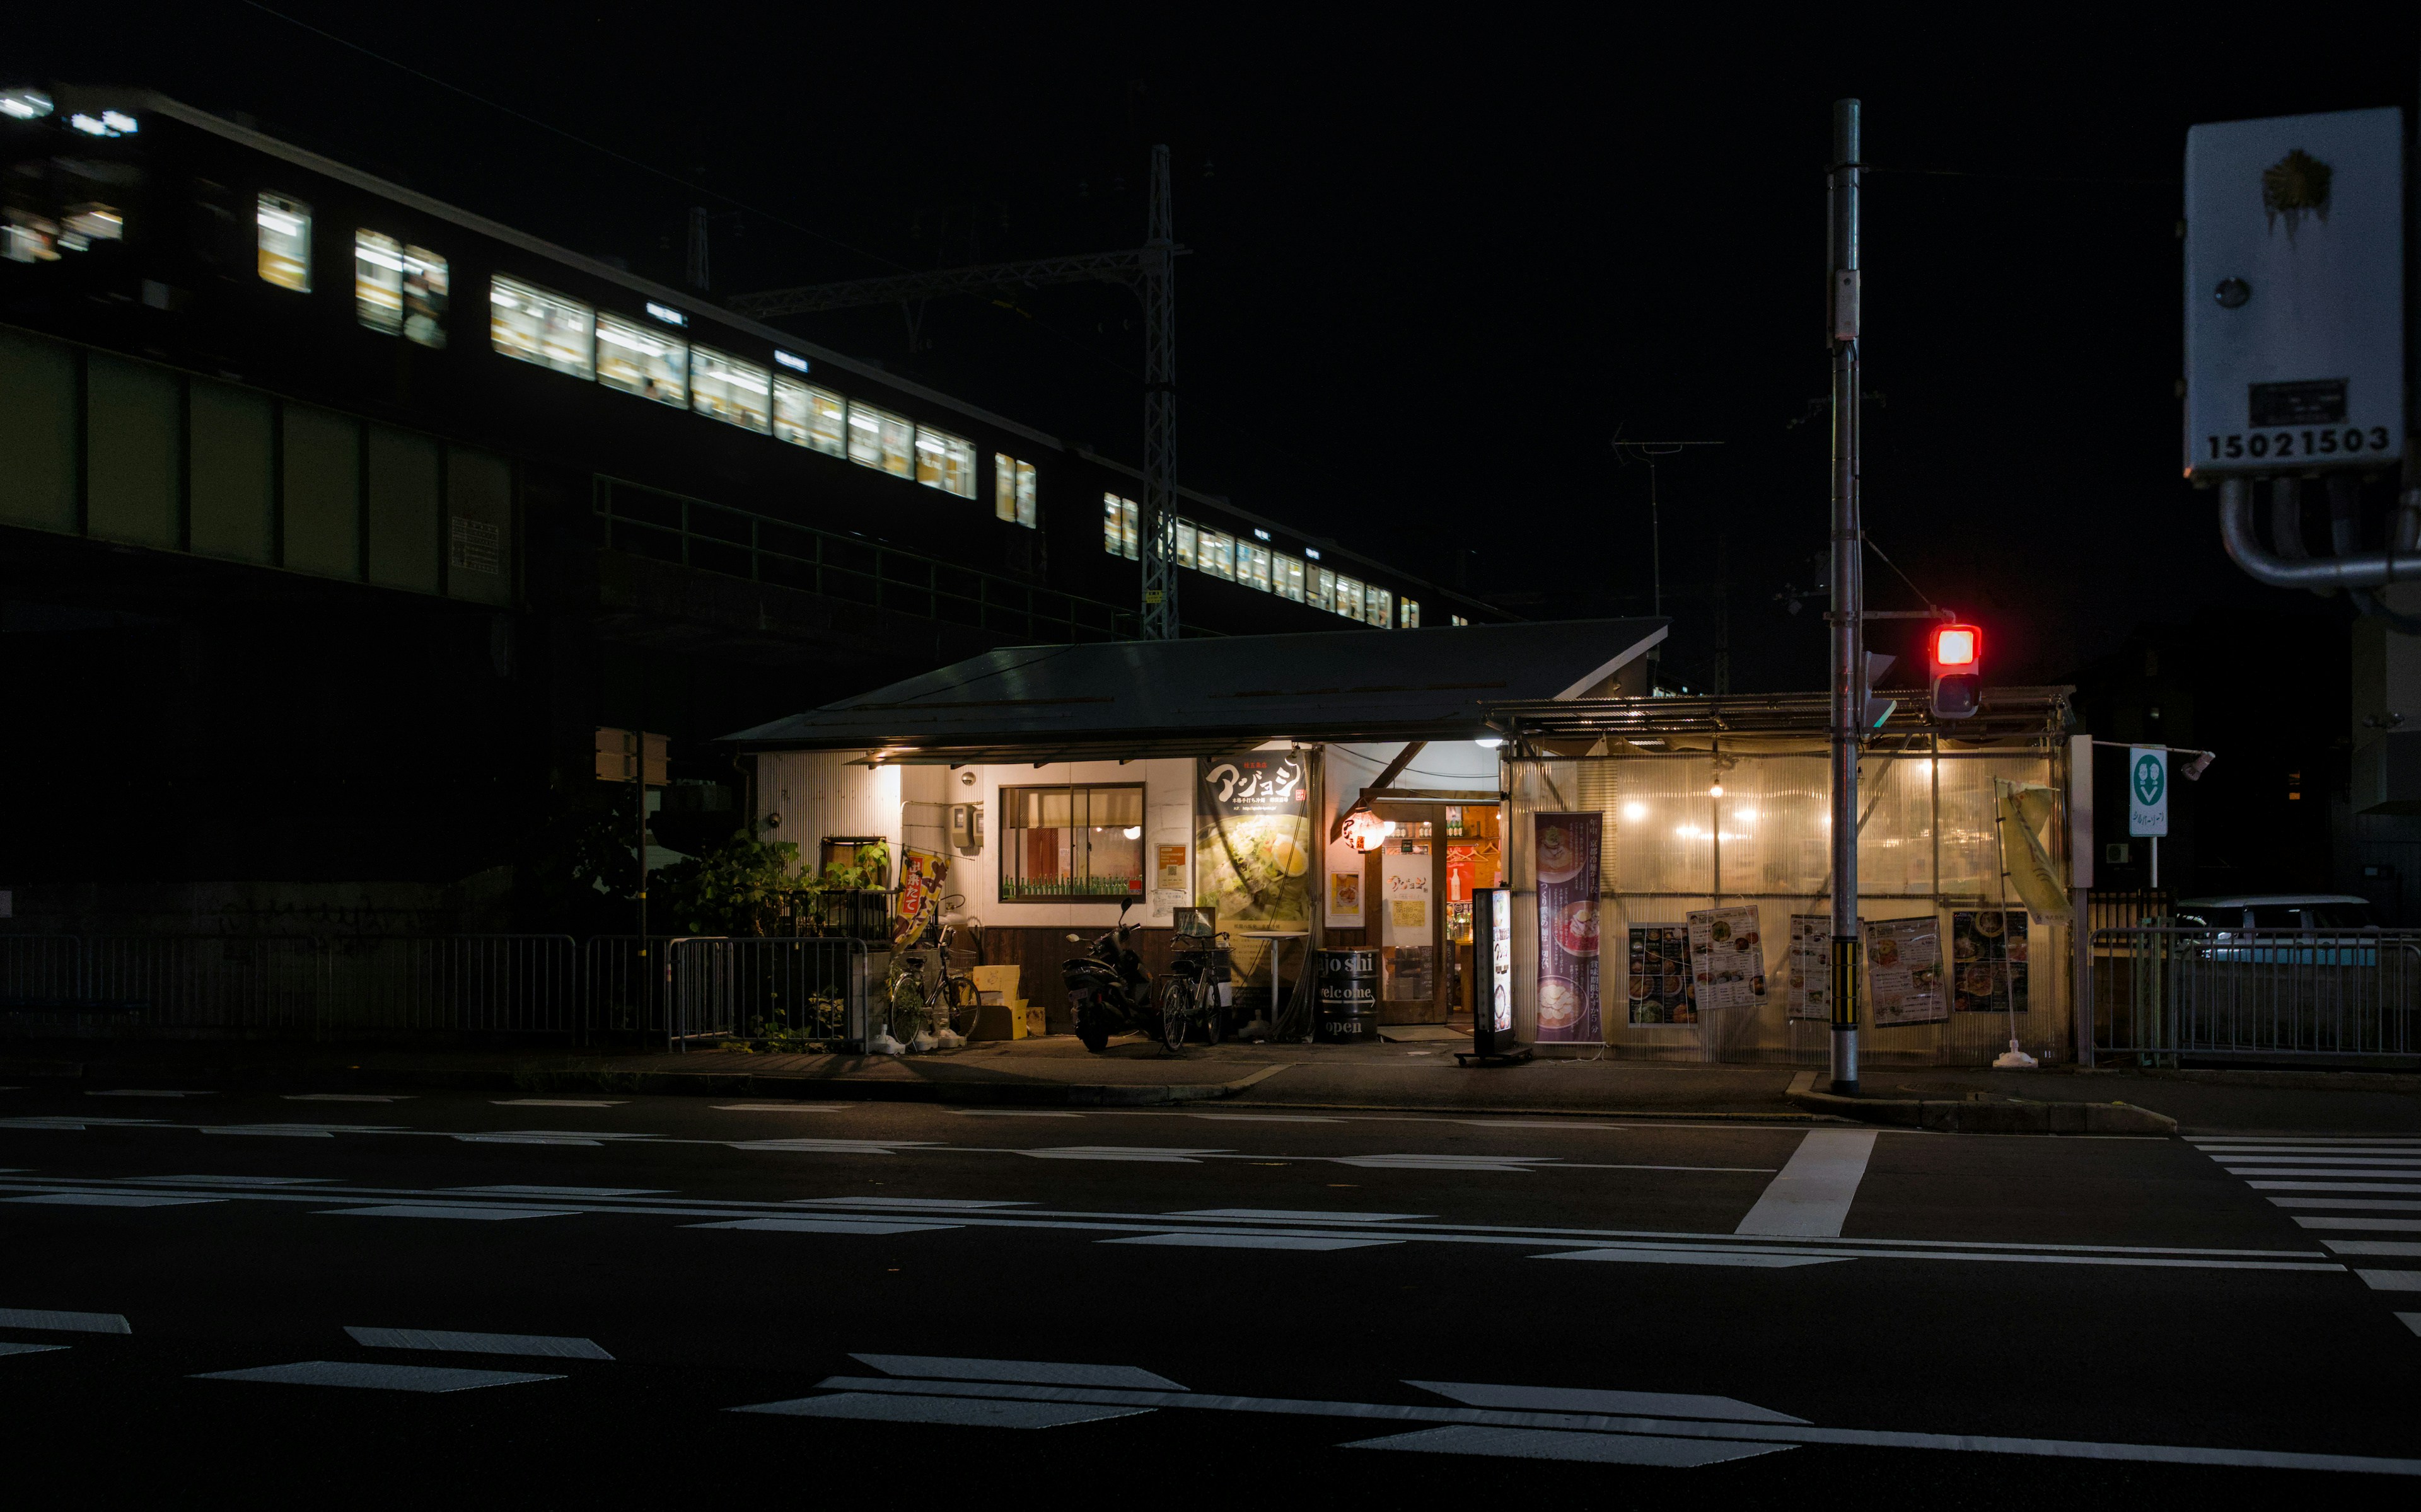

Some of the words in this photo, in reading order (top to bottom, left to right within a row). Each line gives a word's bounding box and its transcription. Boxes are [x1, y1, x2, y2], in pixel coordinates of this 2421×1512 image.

[2209, 427, 2389, 459] 15021503
[1205, 763, 1301, 802] アジョシ
[906, 860, 921, 911] 出来たて
[1590, 961, 1599, 1033] 賞味期限わずか5分
[1325, 1022, 1362, 1036] open
